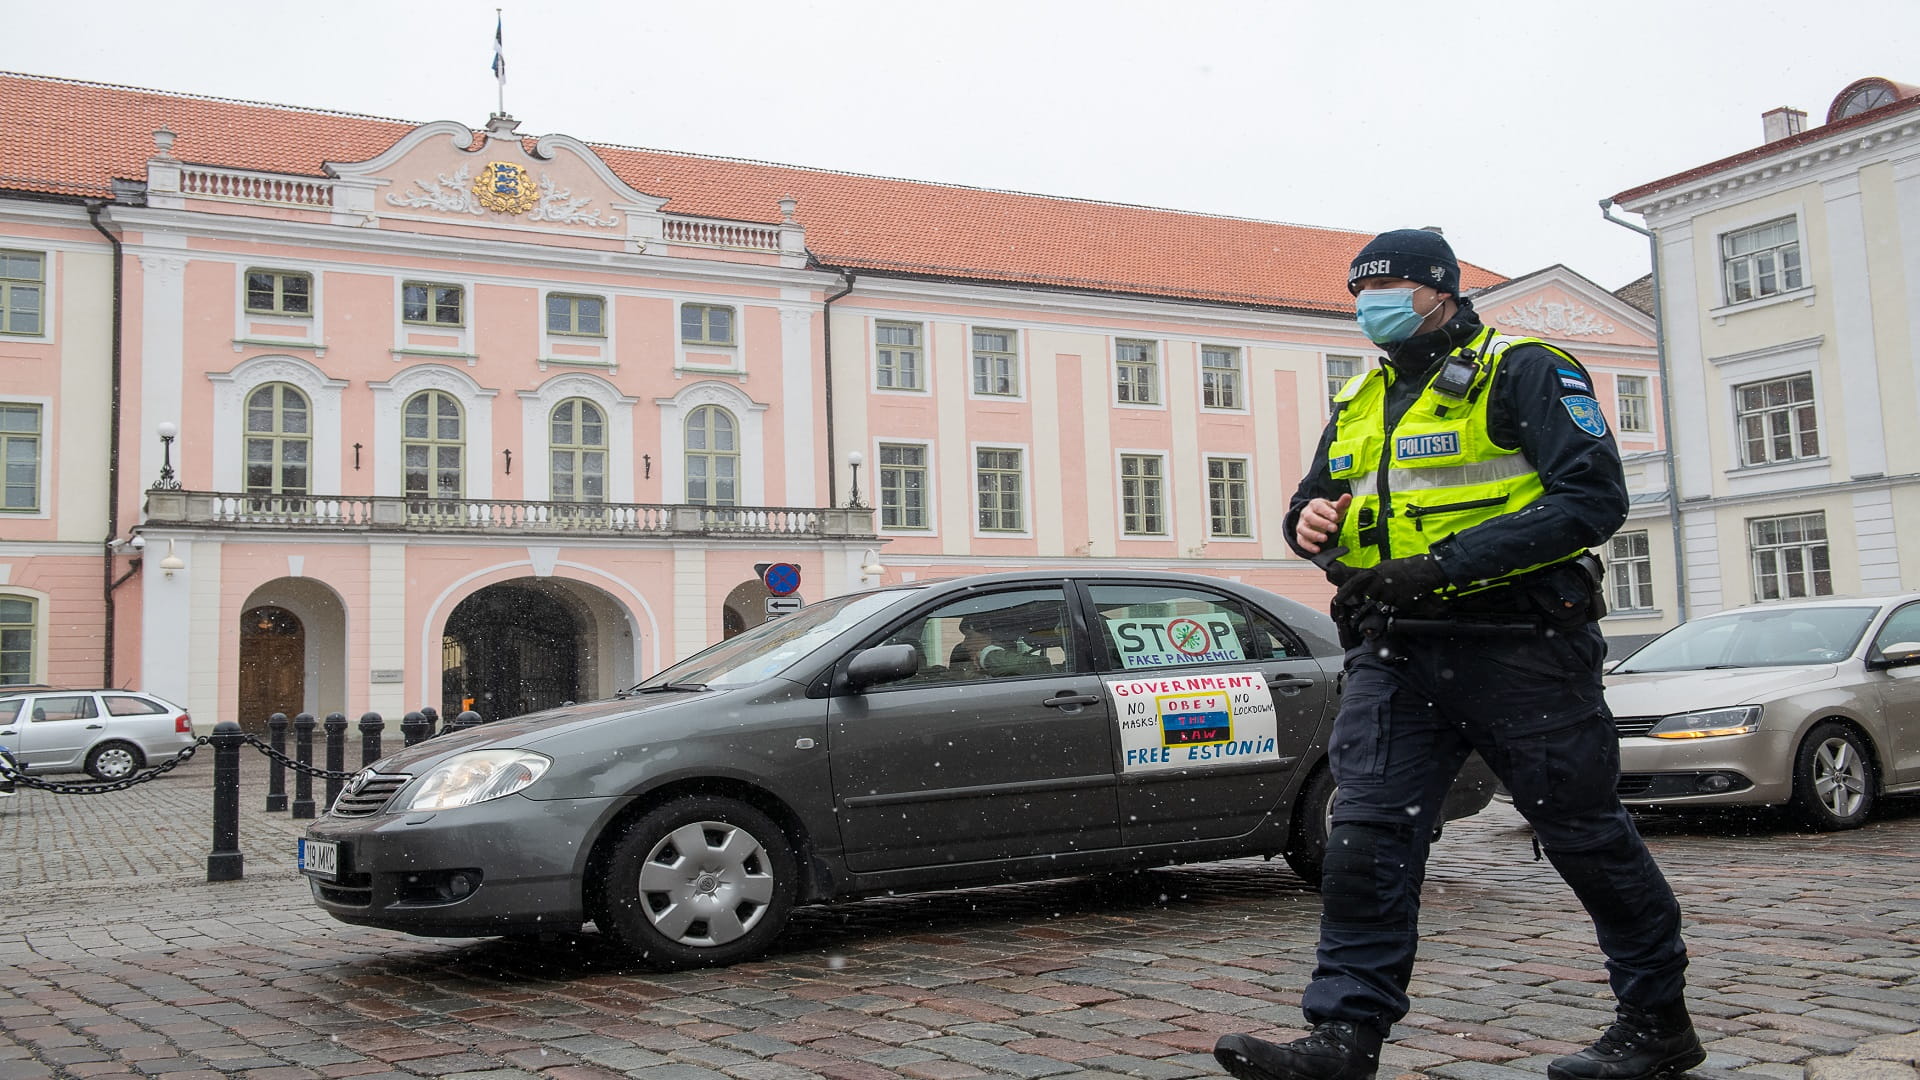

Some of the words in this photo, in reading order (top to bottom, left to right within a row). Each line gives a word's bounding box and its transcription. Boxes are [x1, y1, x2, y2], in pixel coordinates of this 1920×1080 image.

[1349, 260, 1391, 281] OLITSEI
[1399, 434, 1456, 457] POLITSEI
[1117, 619, 1231, 656] STOP
[1127, 654, 1163, 666] FAKE
[1165, 650, 1239, 664] PANDEMIC
[1115, 676, 1262, 697] GOVERNMENT,
[1168, 698, 1215, 711] OBEY
[1234, 693, 1250, 704] NO
[1127, 701, 1145, 716] NO
[1122, 713, 1158, 730] MASKS!
[1177, 715, 1206, 726] THE
[1180, 729, 1217, 741] LAW
[1127, 746, 1171, 766] FREE
